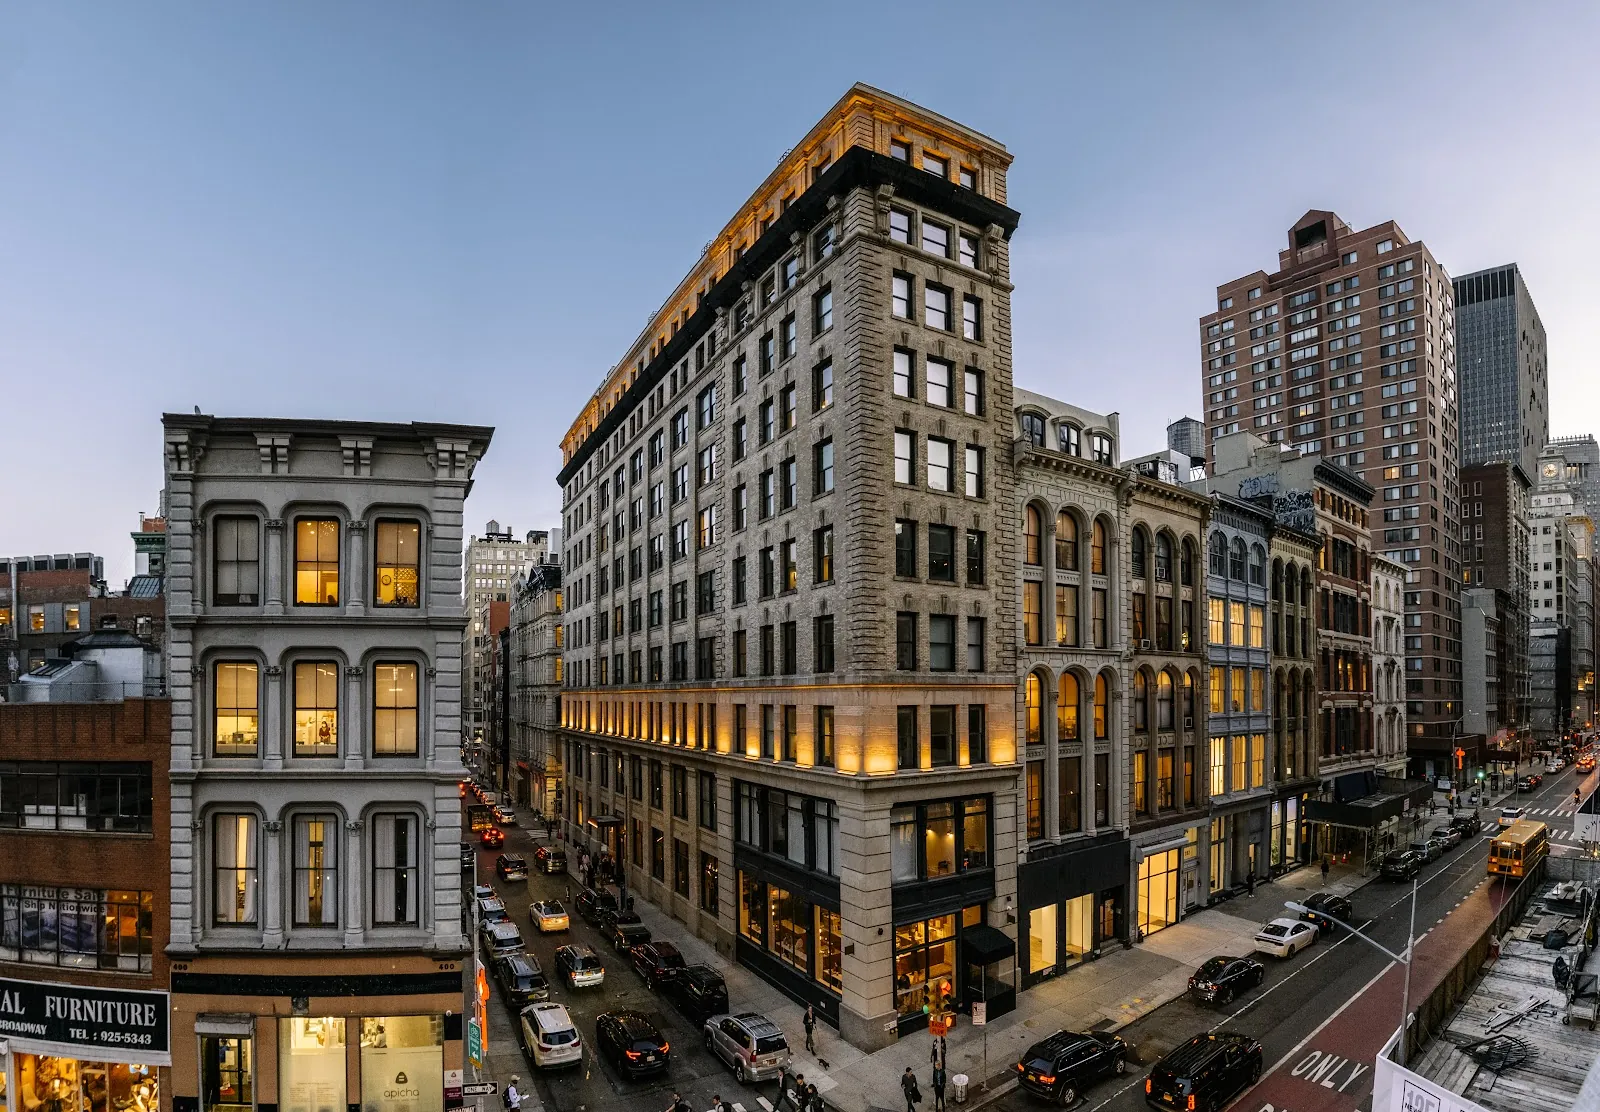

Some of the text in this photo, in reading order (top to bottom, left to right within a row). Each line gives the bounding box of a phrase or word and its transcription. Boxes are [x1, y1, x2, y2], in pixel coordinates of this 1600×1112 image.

[7, 885, 70, 899] Frnitue
[24, 900, 45, 912] Shp
[48, 902, 105, 915] Ntiowide
[173, 963, 188, 971] 400
[0, 989, 157, 1027] AL FURNITURE
[100, 1031, 152, 1045] 925-5343
[1291, 1050, 1370, 1093] ONLY
[383, 1087, 420, 1100] apicha
